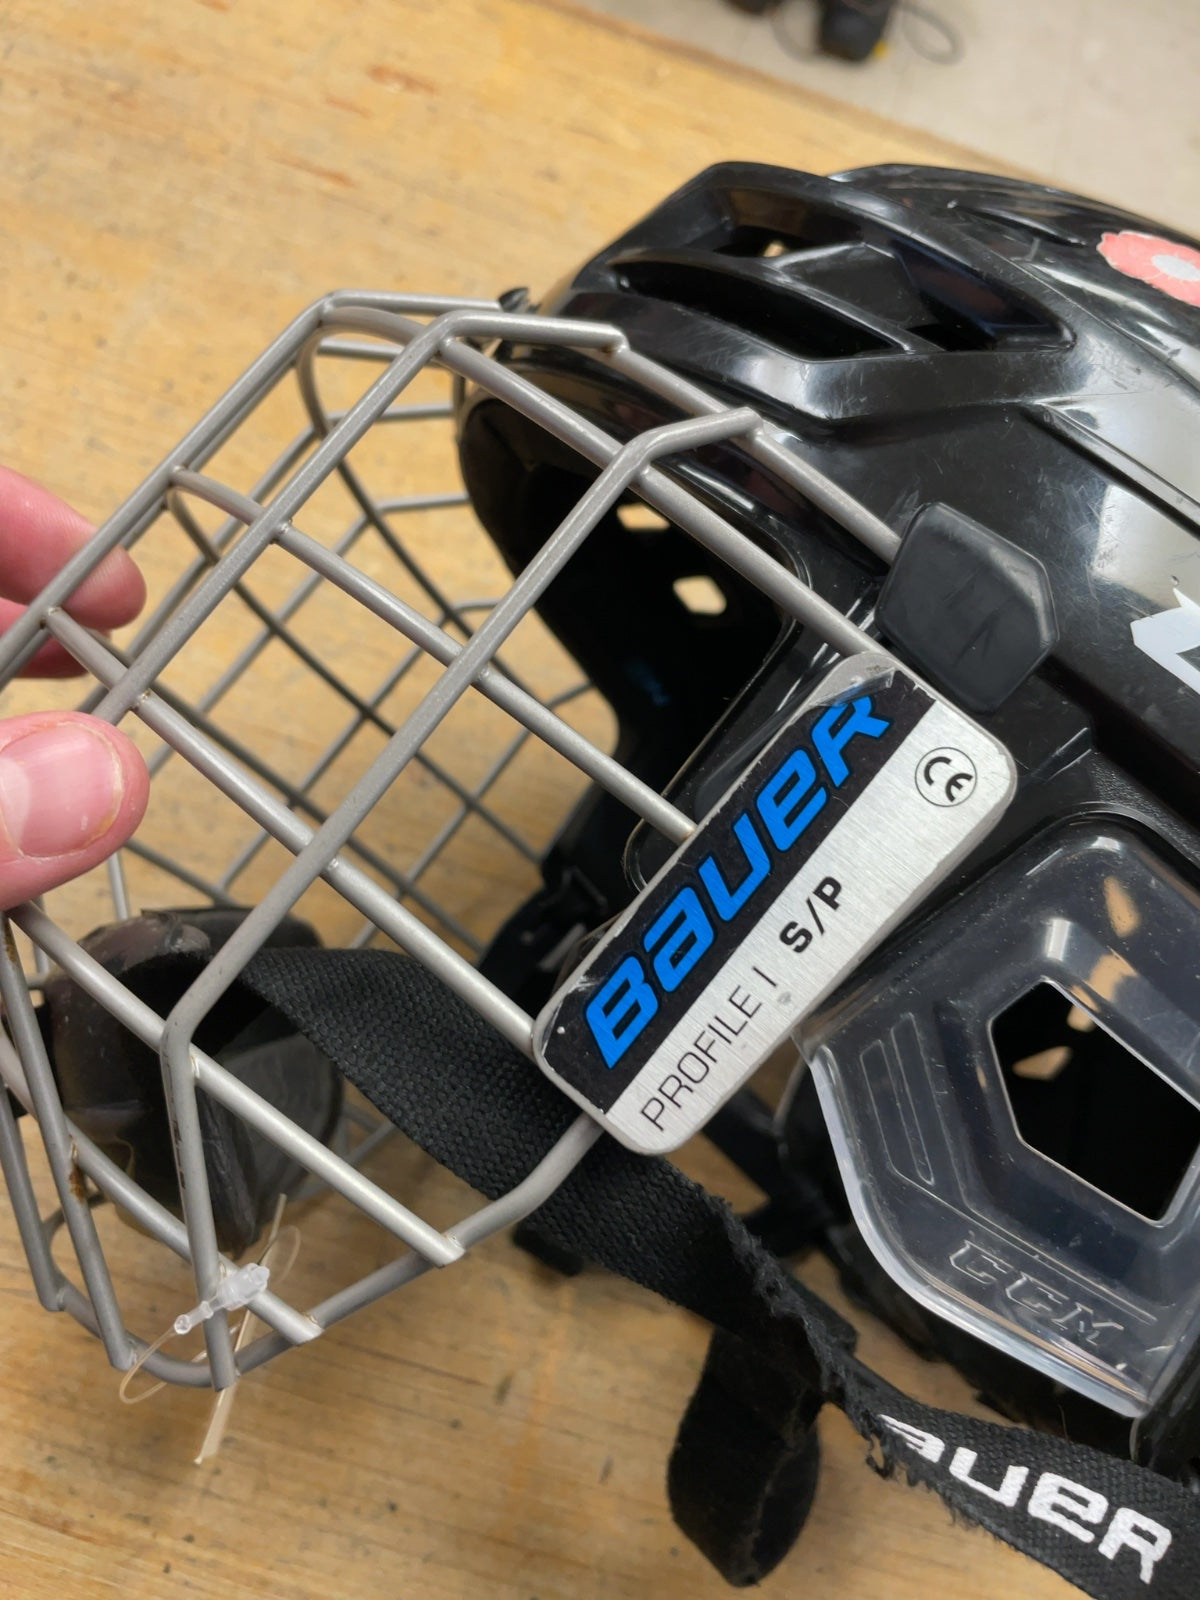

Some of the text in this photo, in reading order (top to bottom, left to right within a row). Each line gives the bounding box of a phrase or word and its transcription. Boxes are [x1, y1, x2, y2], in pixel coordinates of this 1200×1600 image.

[639, 984, 763, 1132] PROFILE
[778, 875, 843, 954] S/P
[949, 1239, 1126, 1347] CCM
[878, 1413, 1173, 1584] AUER
